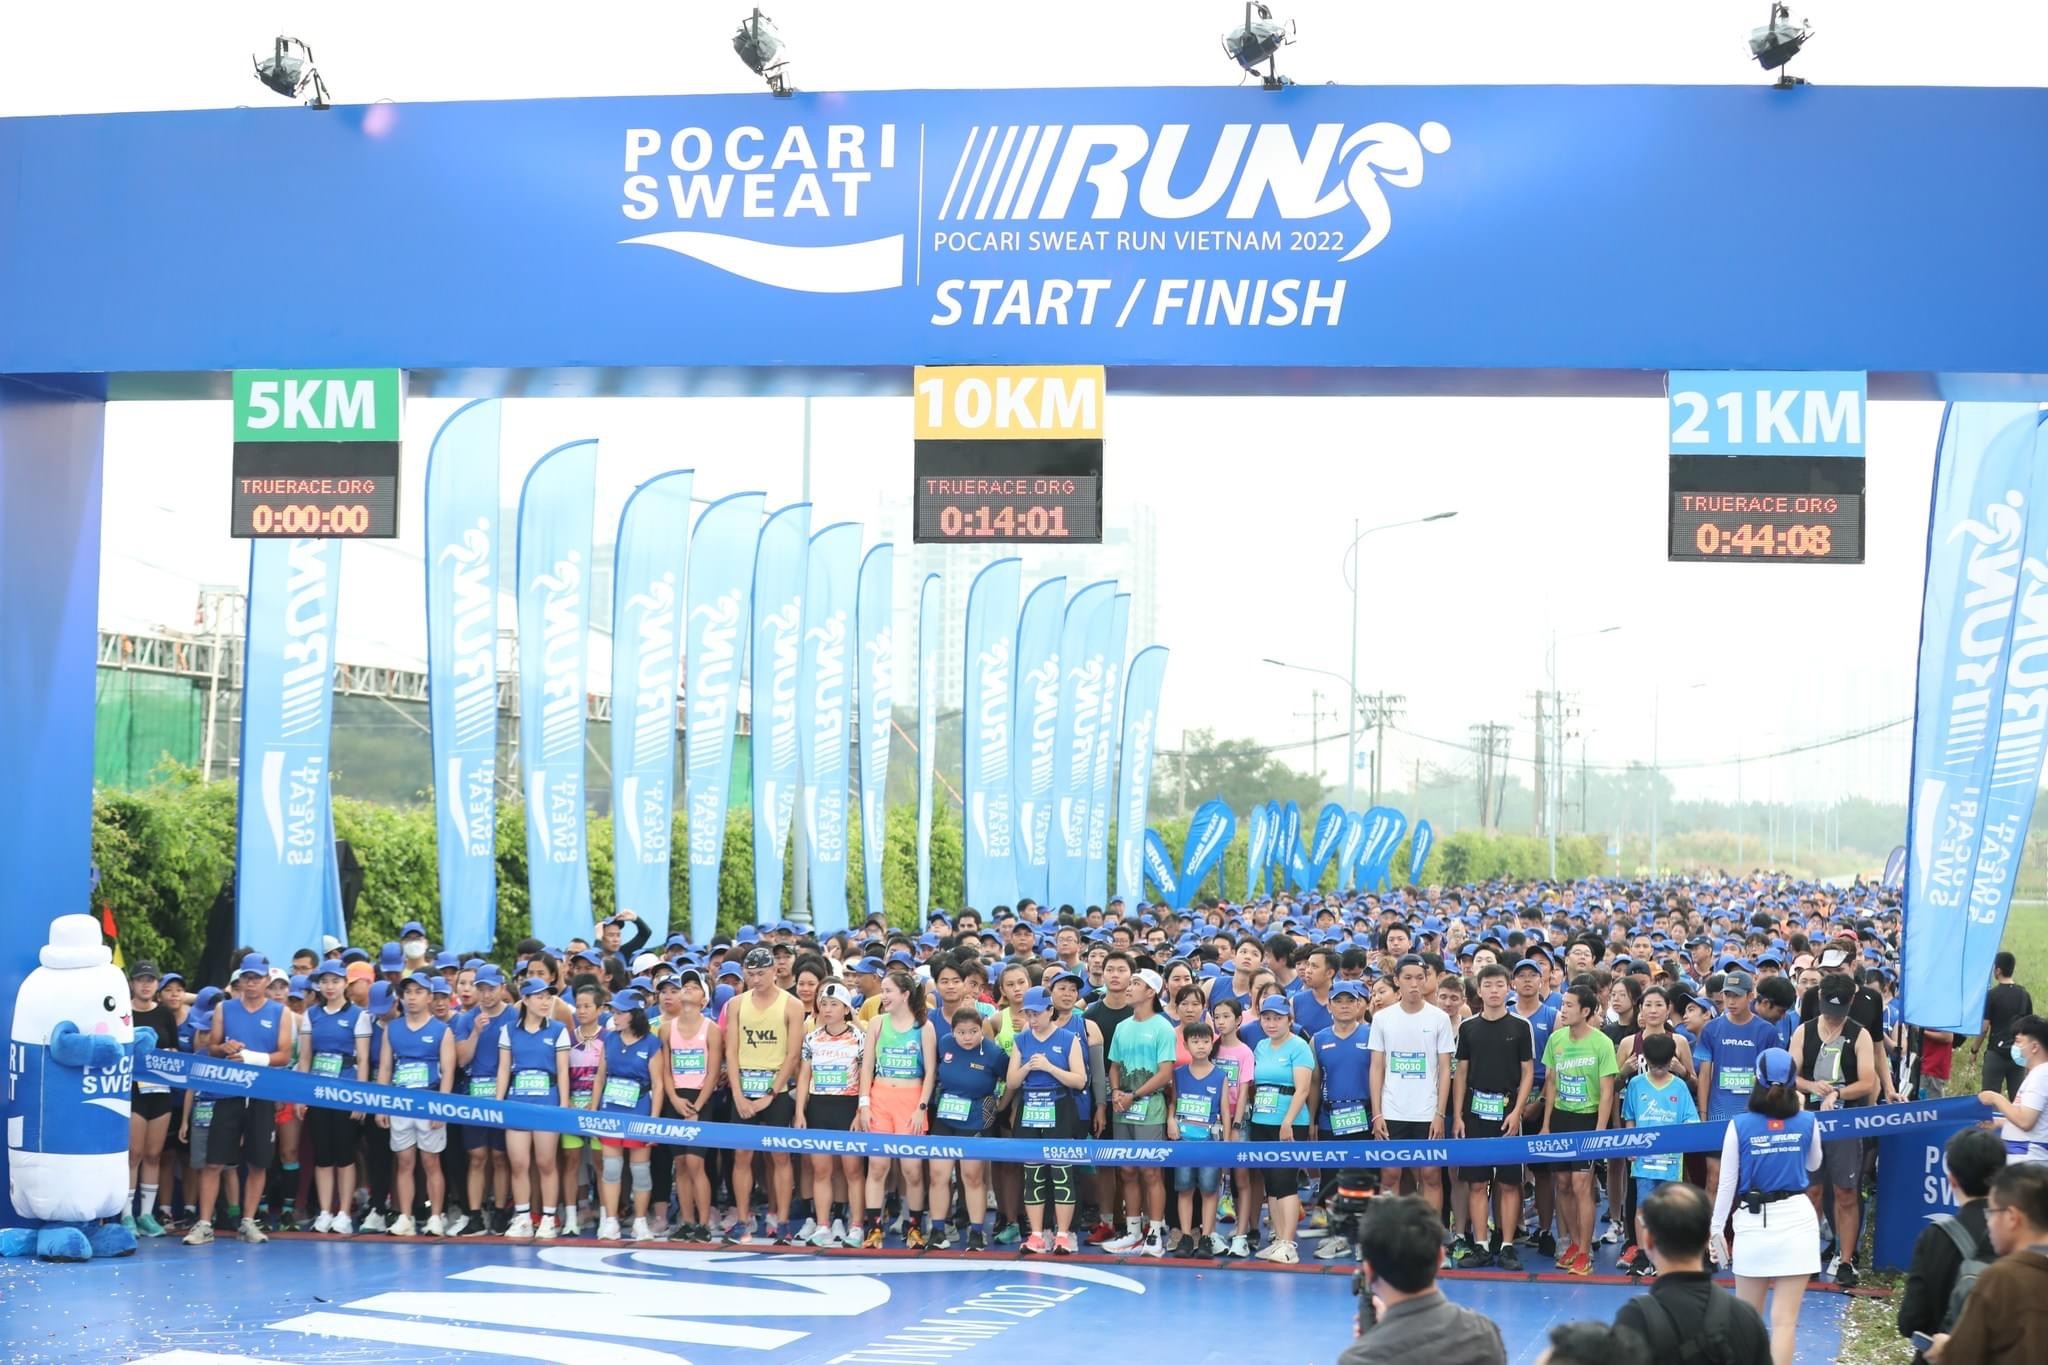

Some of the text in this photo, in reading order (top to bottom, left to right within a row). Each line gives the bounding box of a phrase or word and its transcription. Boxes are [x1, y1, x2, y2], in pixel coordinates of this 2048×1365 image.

[624, 124, 895, 172] POCARI
[622, 171, 872, 222] SWEAT
[933, 231, 1345, 252] POCARI SWEAT RUN VIETNAM 2022
[931, 278, 1110, 326] START
[1153, 278, 1347, 326] FINISH
[246, 380, 376, 430] 5KM
[919, 377, 1097, 429] 10KM
[1672, 390, 1862, 444] 21KM
[241, 479, 376, 495] TRUERACE.ORG
[927, 480, 1075, 495] TRUERACE.ORG
[1682, 496, 1839, 513] TRUERACE.ORG
[252, 505, 369, 533] 0:00:00
[940, 506, 1069, 536] 0:14:01
[1696, 523, 1832, 556] 0:44:08
[145, 1054, 185, 1068] POCARI
[146, 1061, 181, 1073] SWEAT
[1395, 1061, 1421, 1071] 50030
[314, 1085, 414, 1112] #NOSWEAT
[428, 1103, 504, 1124] NOGAIN
[578, 1116, 621, 1127] POCARI
[1336, 1116, 1362, 1128] 51632
[1855, 1110, 1938, 1130] NOGAIN
[761, 1136, 868, 1154] #NOSWEAT
[883, 1143, 964, 1158] NOGAIN
[1042, 1146, 1088, 1154] POCARI
[1528, 1138, 1573, 1147] POCARI
[1528, 1144, 1570, 1154] SWEAT
[1236, 1150, 1349, 1163] #NOSWEAT
[1365, 1149, 1448, 1162] NOGAIN
[944, 1284, 1089, 1318] 2022
